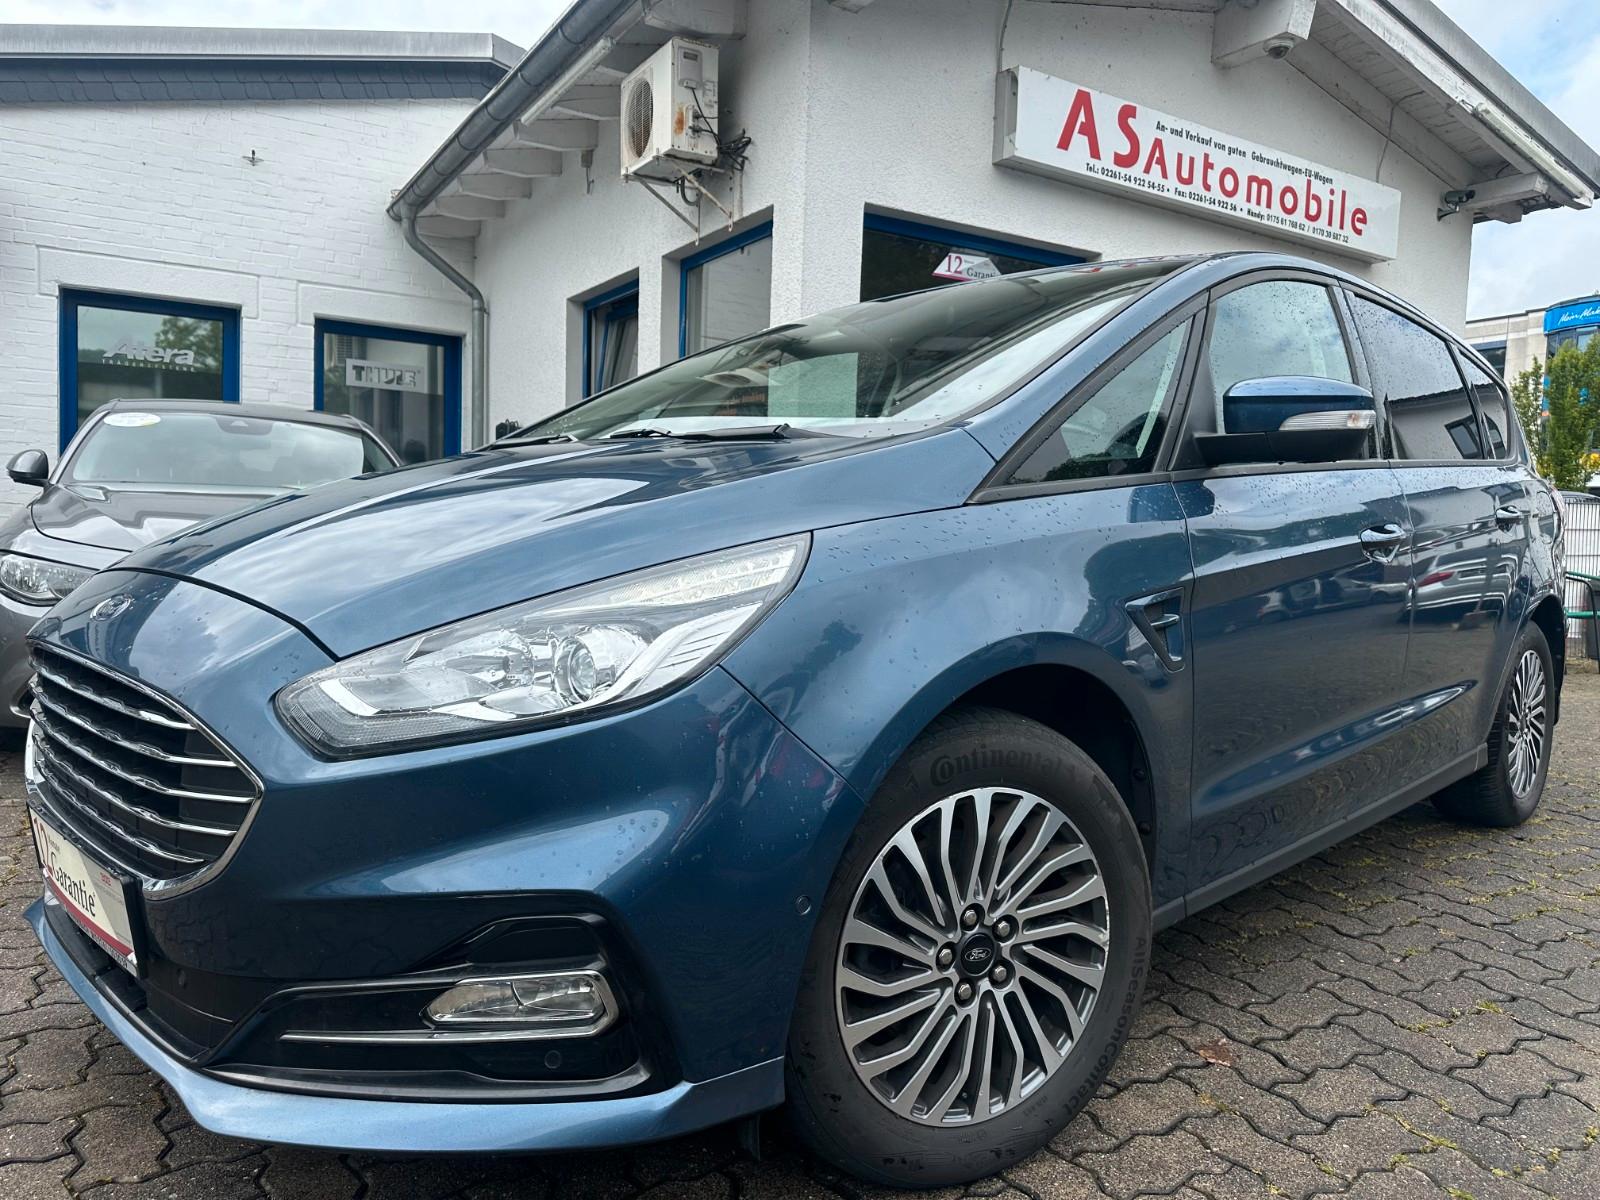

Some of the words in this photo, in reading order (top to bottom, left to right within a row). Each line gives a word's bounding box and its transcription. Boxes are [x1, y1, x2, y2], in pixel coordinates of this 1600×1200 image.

[1156, 120, 1169, 132] An-
[1170, 125, 1183, 138] und
[1185, 130, 1212, 147] Verkauf
[1213, 141, 1226, 151] von
[1227, 146, 1247, 158] guten
[1086, 163, 1100, 174] Tel.:
[1101, 167, 1132, 183] 02261-54
[1133, 177, 1146, 187] 922
[1147, 182, 1165, 192] 54-55
[1174, 187, 1187, 198] Fax:
[1188, 191, 1216, 206] 02261-54
[1217, 199, 1229, 209] 922
[1230, 202, 1237, 212] 56
[1266, 213, 1279, 225] 0175
[1143, 137, 1368, 236] Automobile
[946, 254, 962, 274] 12
[103, 343, 195, 366] Atera
[352, 365, 417, 389] THULE
[930, 744, 1062, 786] Continental
[50, 851, 96, 918] Garantie
